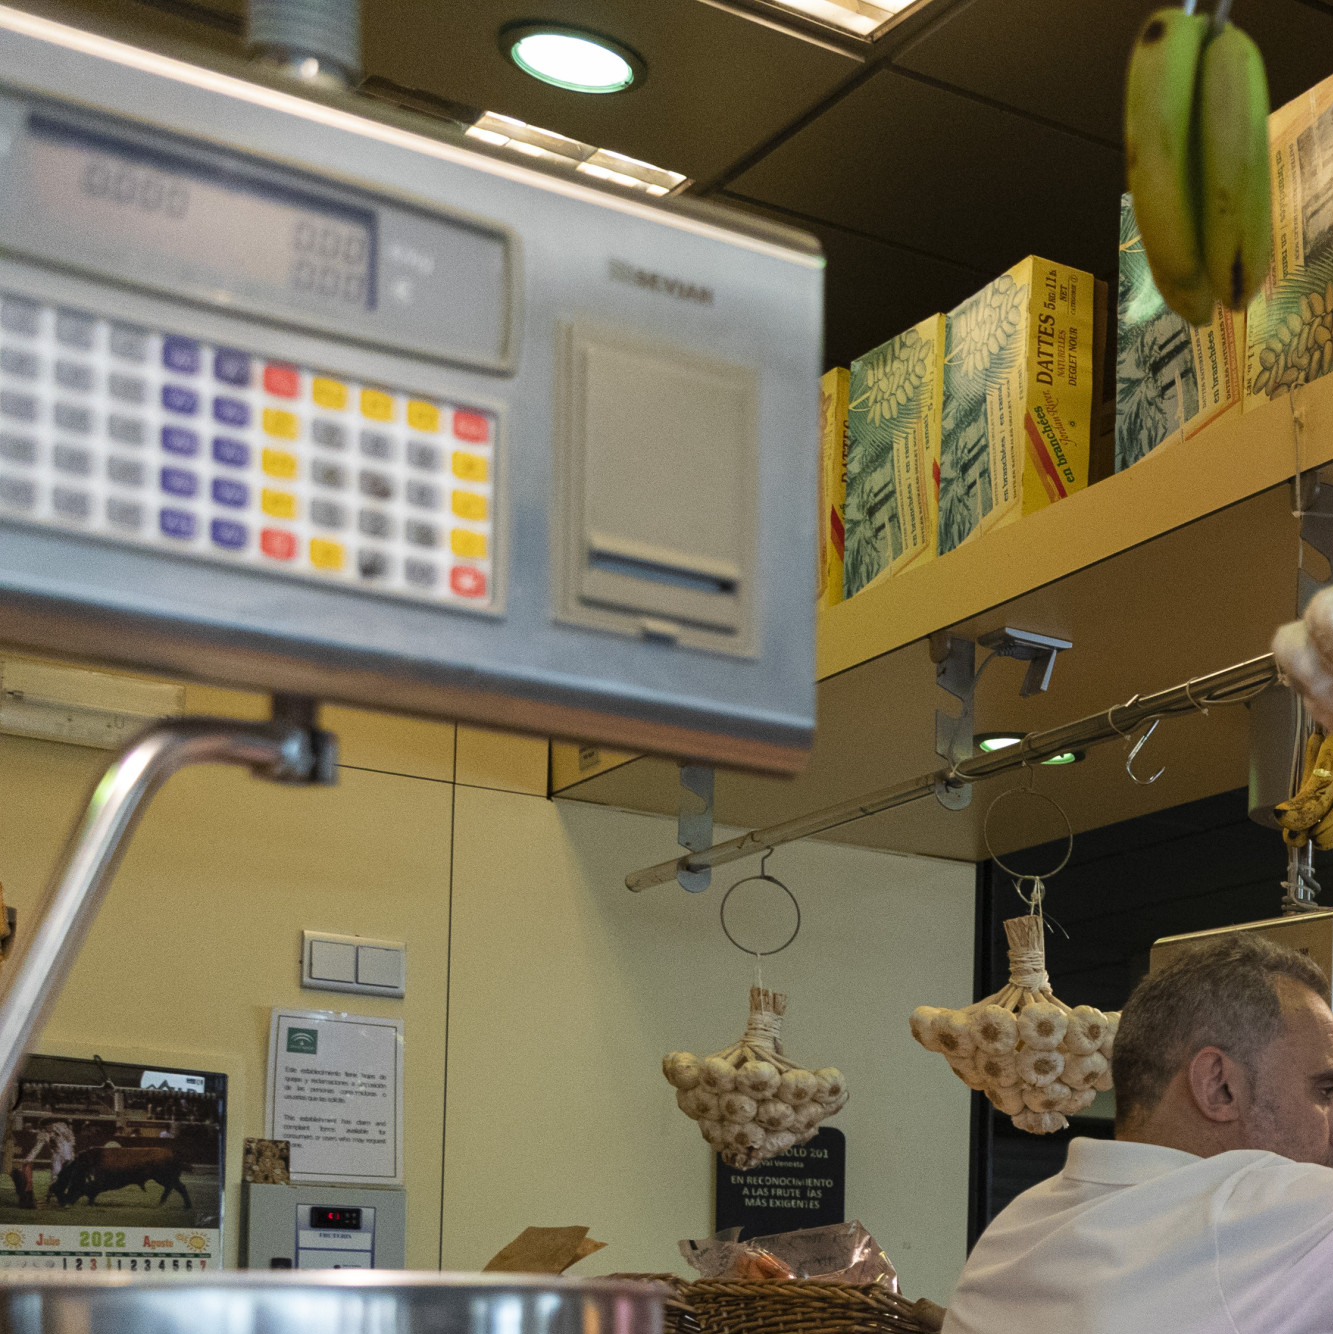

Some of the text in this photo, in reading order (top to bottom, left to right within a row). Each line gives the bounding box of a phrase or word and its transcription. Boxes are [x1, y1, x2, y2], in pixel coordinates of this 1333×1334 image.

[1036, 313, 1055, 386] DATTES
[1057, 330, 1066, 377] NATURELLES
[1068, 327, 1078, 386] DEGLET NOUR
[1213, 390, 1220, 403] en
[1033, 405, 1075, 483] en branchées
[731, 1175, 744, 1184] EN
[742, 1187, 750, 1195] A
[752, 1188, 768, 1196] LAS
[744, 1197, 820, 1209] MÁS EXIGENTES
[79, 1231, 126, 1248] 2022
[143, 1235, 173, 1249] Agosto
